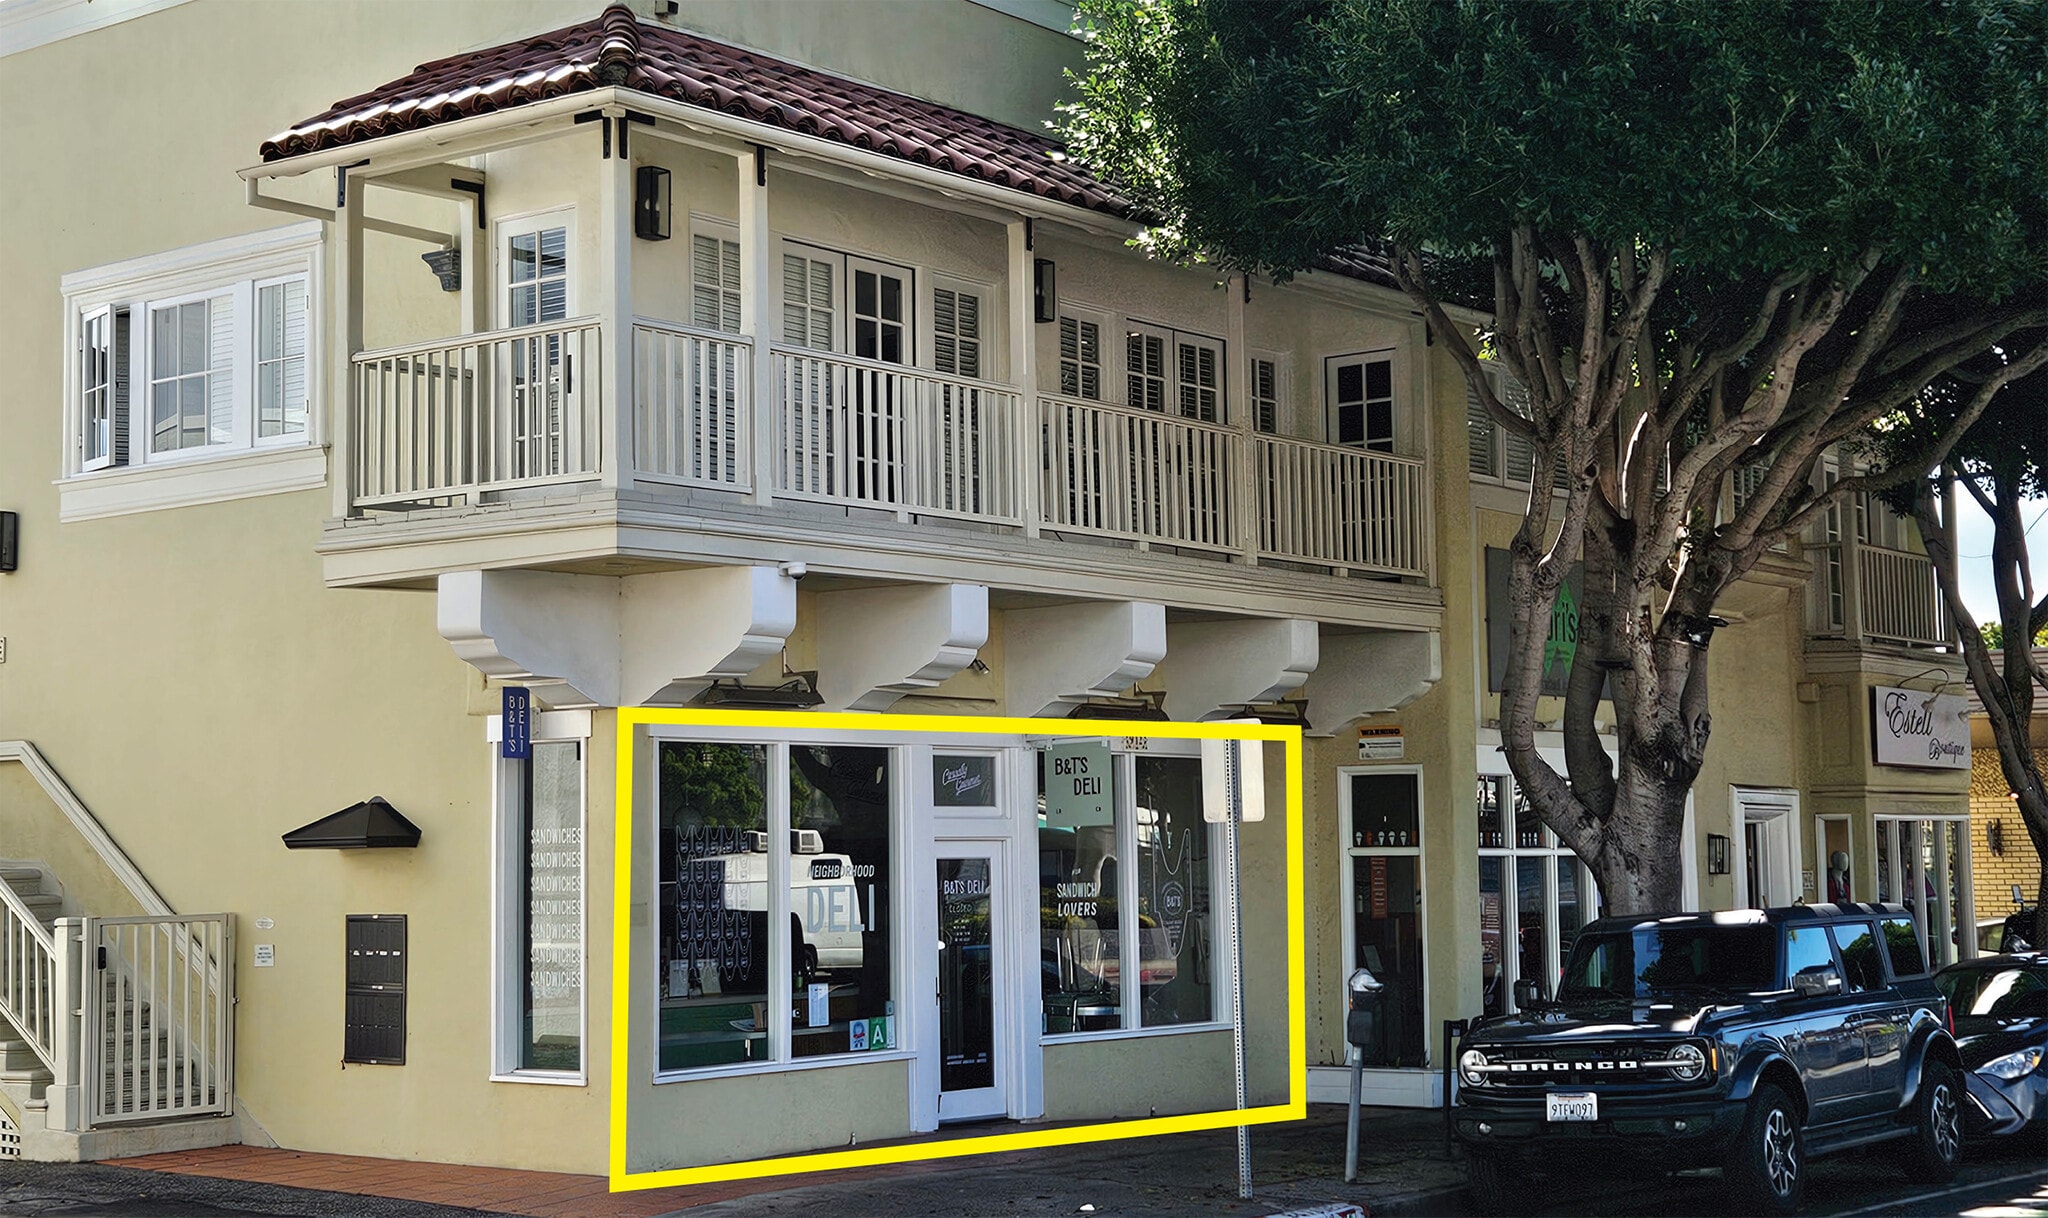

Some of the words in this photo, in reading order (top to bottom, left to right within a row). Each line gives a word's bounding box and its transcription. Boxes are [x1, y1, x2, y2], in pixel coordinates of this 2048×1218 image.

[1885, 692, 1933, 738] Estell
[1073, 777, 1101, 795] DELI
[531, 828, 581, 844] SANDWICHES
[531, 852, 581, 868] SANDWICHES
[807, 865, 875, 878] NEIGHBORHOOD
[531, 876, 581, 892] SANDWICHES
[967, 879, 985, 894] DELI
[1056, 882, 1097, 898] SANDWICH
[531, 900, 581, 915] SANDWICHES
[807, 884, 875, 933] DELI
[1058, 902, 1098, 917] LOVERS
[531, 924, 581, 939] SANDWICHES
[531, 947, 581, 963] SANDWICHES
[531, 971, 581, 987] SANDWICHES
[872, 1024, 884, 1045] A
[1511, 1061, 1637, 1072] BRONCO
